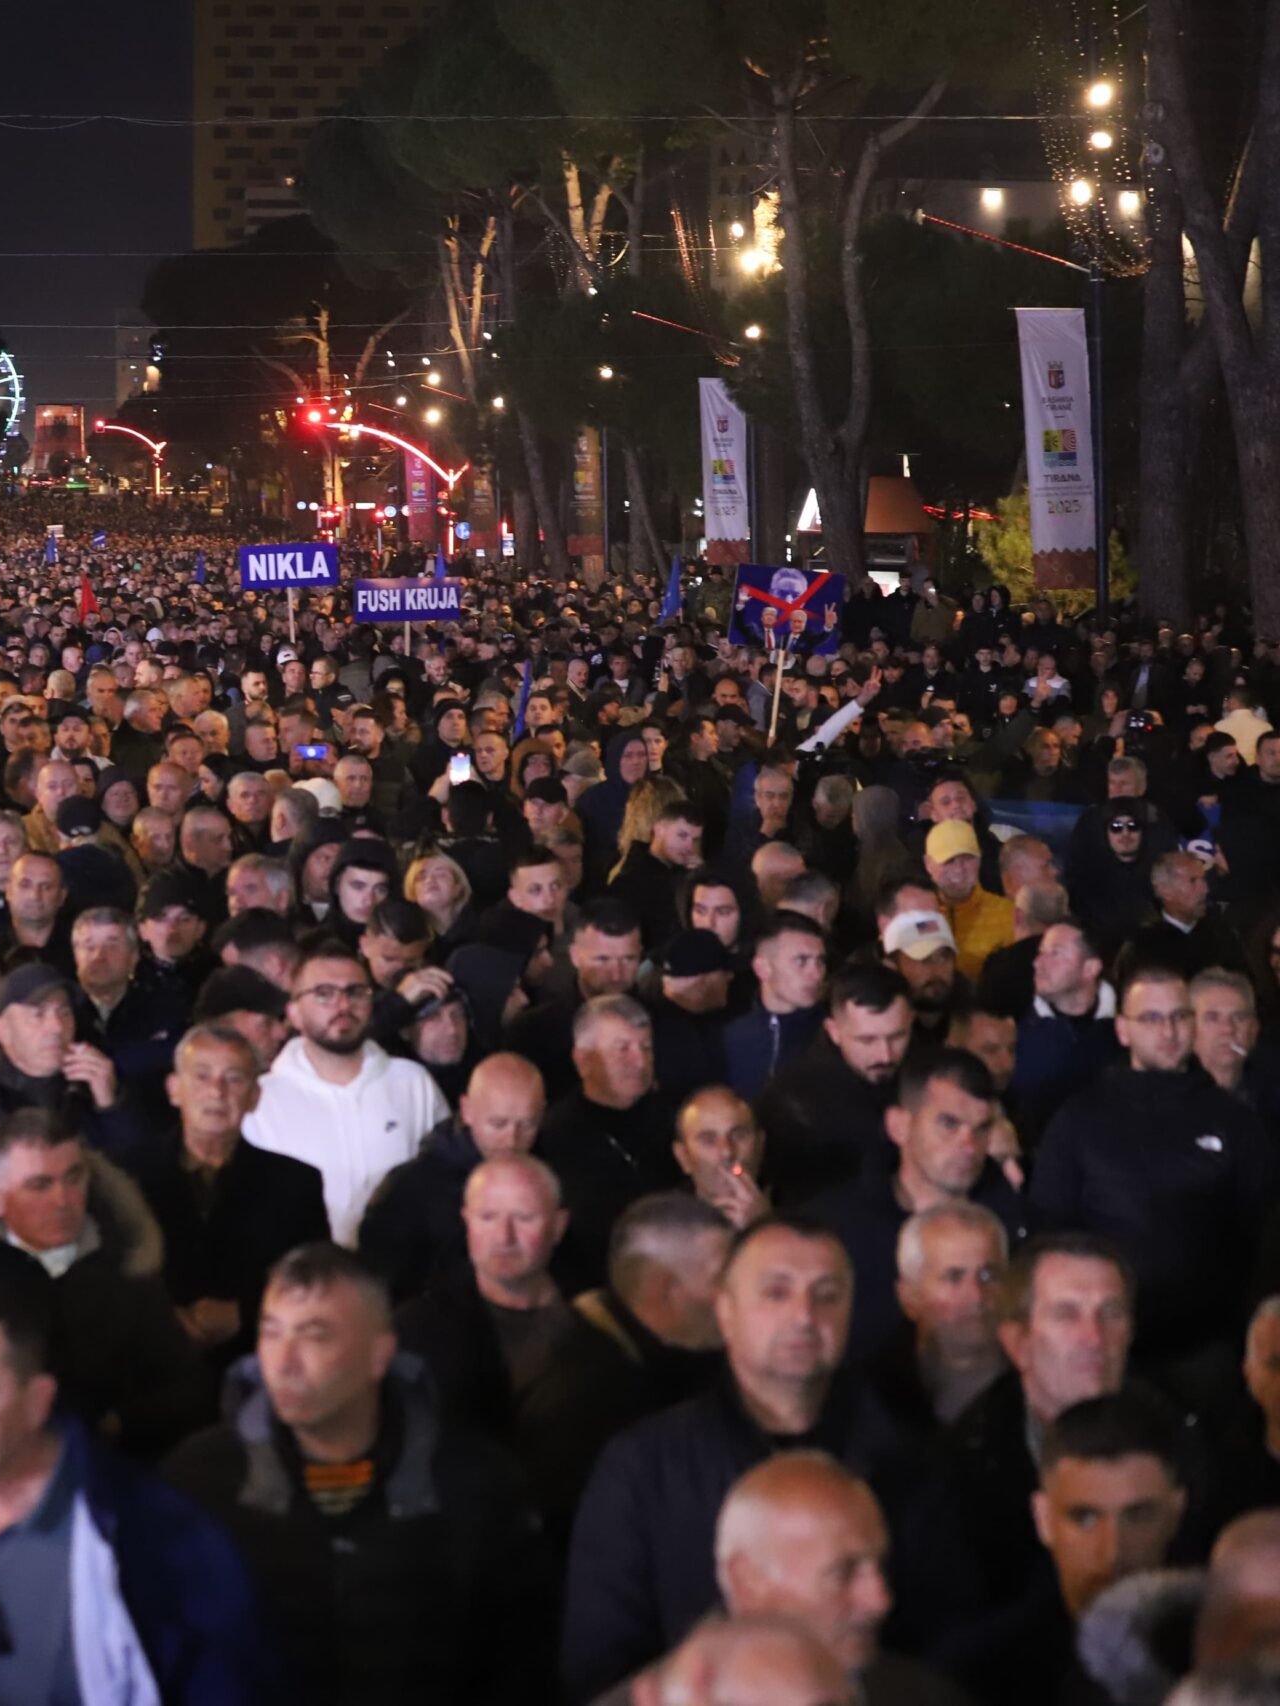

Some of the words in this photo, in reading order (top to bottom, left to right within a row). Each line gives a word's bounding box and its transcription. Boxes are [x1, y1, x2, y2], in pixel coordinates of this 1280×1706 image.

[1043, 473, 1082, 482] TIRANA
[1047, 499, 1082, 514] 2025
[248, 550, 330, 581] NIKLA
[357, 589, 401, 612] FUSH
[404, 587, 458, 610] KRUJA
